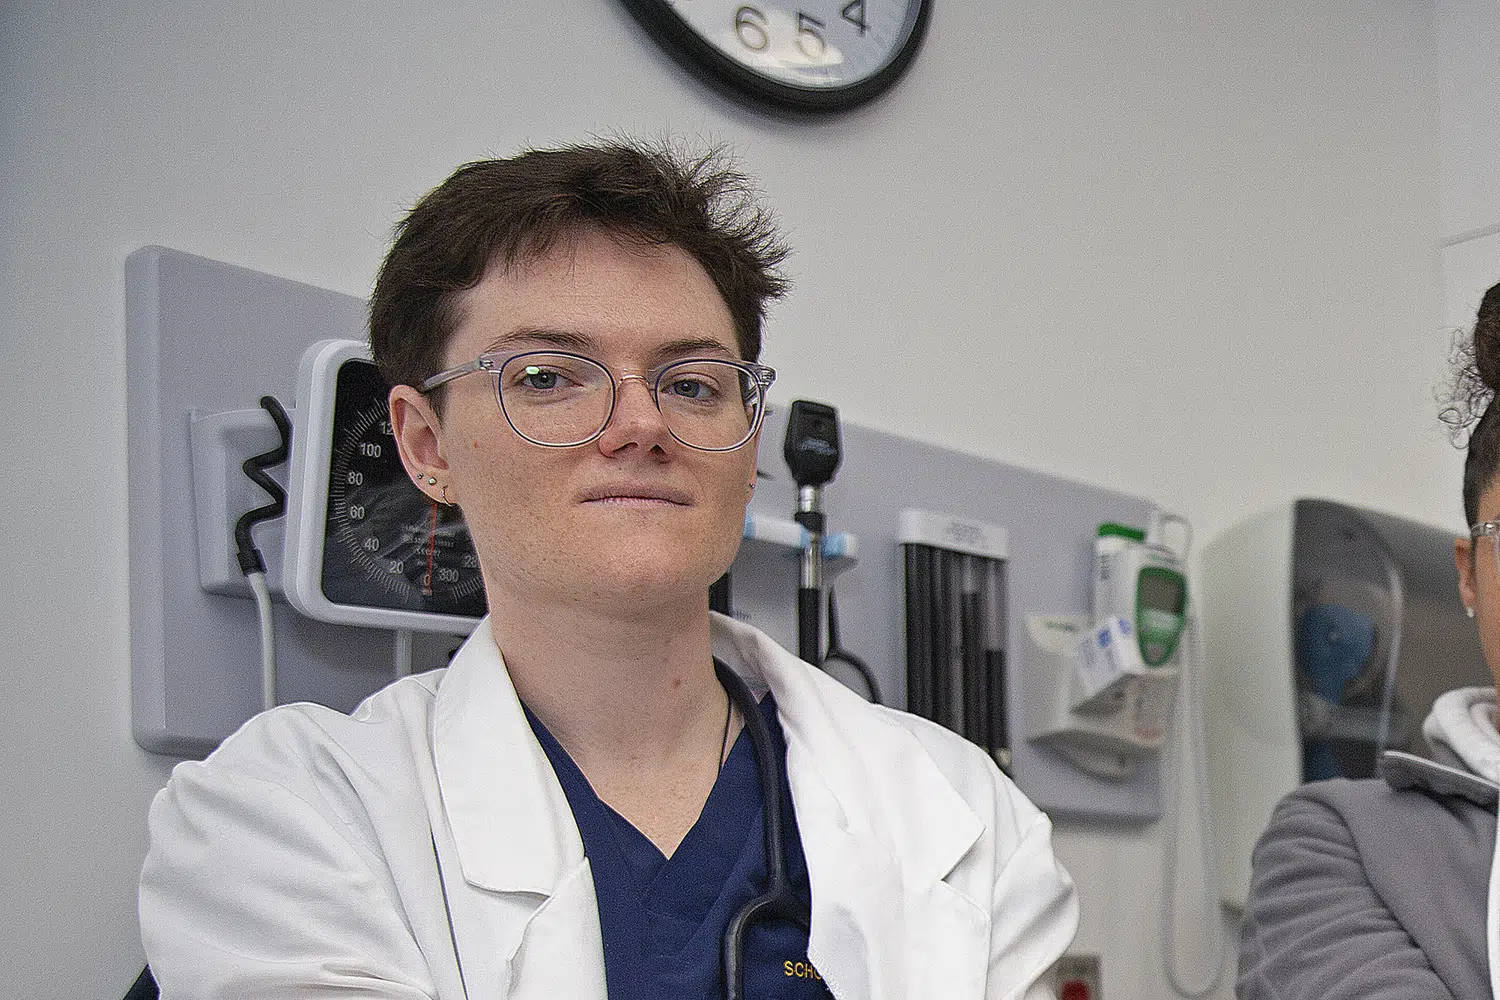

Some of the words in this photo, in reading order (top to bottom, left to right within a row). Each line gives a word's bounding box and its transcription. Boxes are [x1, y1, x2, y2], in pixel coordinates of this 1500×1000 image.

[840, 0, 871, 37] 4
[735, 6, 768, 50] 6
[797, 12, 826, 58] 5
[360, 443, 381, 458] 100
[348, 472, 363, 486] 80
[350, 506, 365, 520] 60
[364, 538, 379, 551] 40
[389, 561, 404, 574] 20
[439, 567, 459, 583] 300
